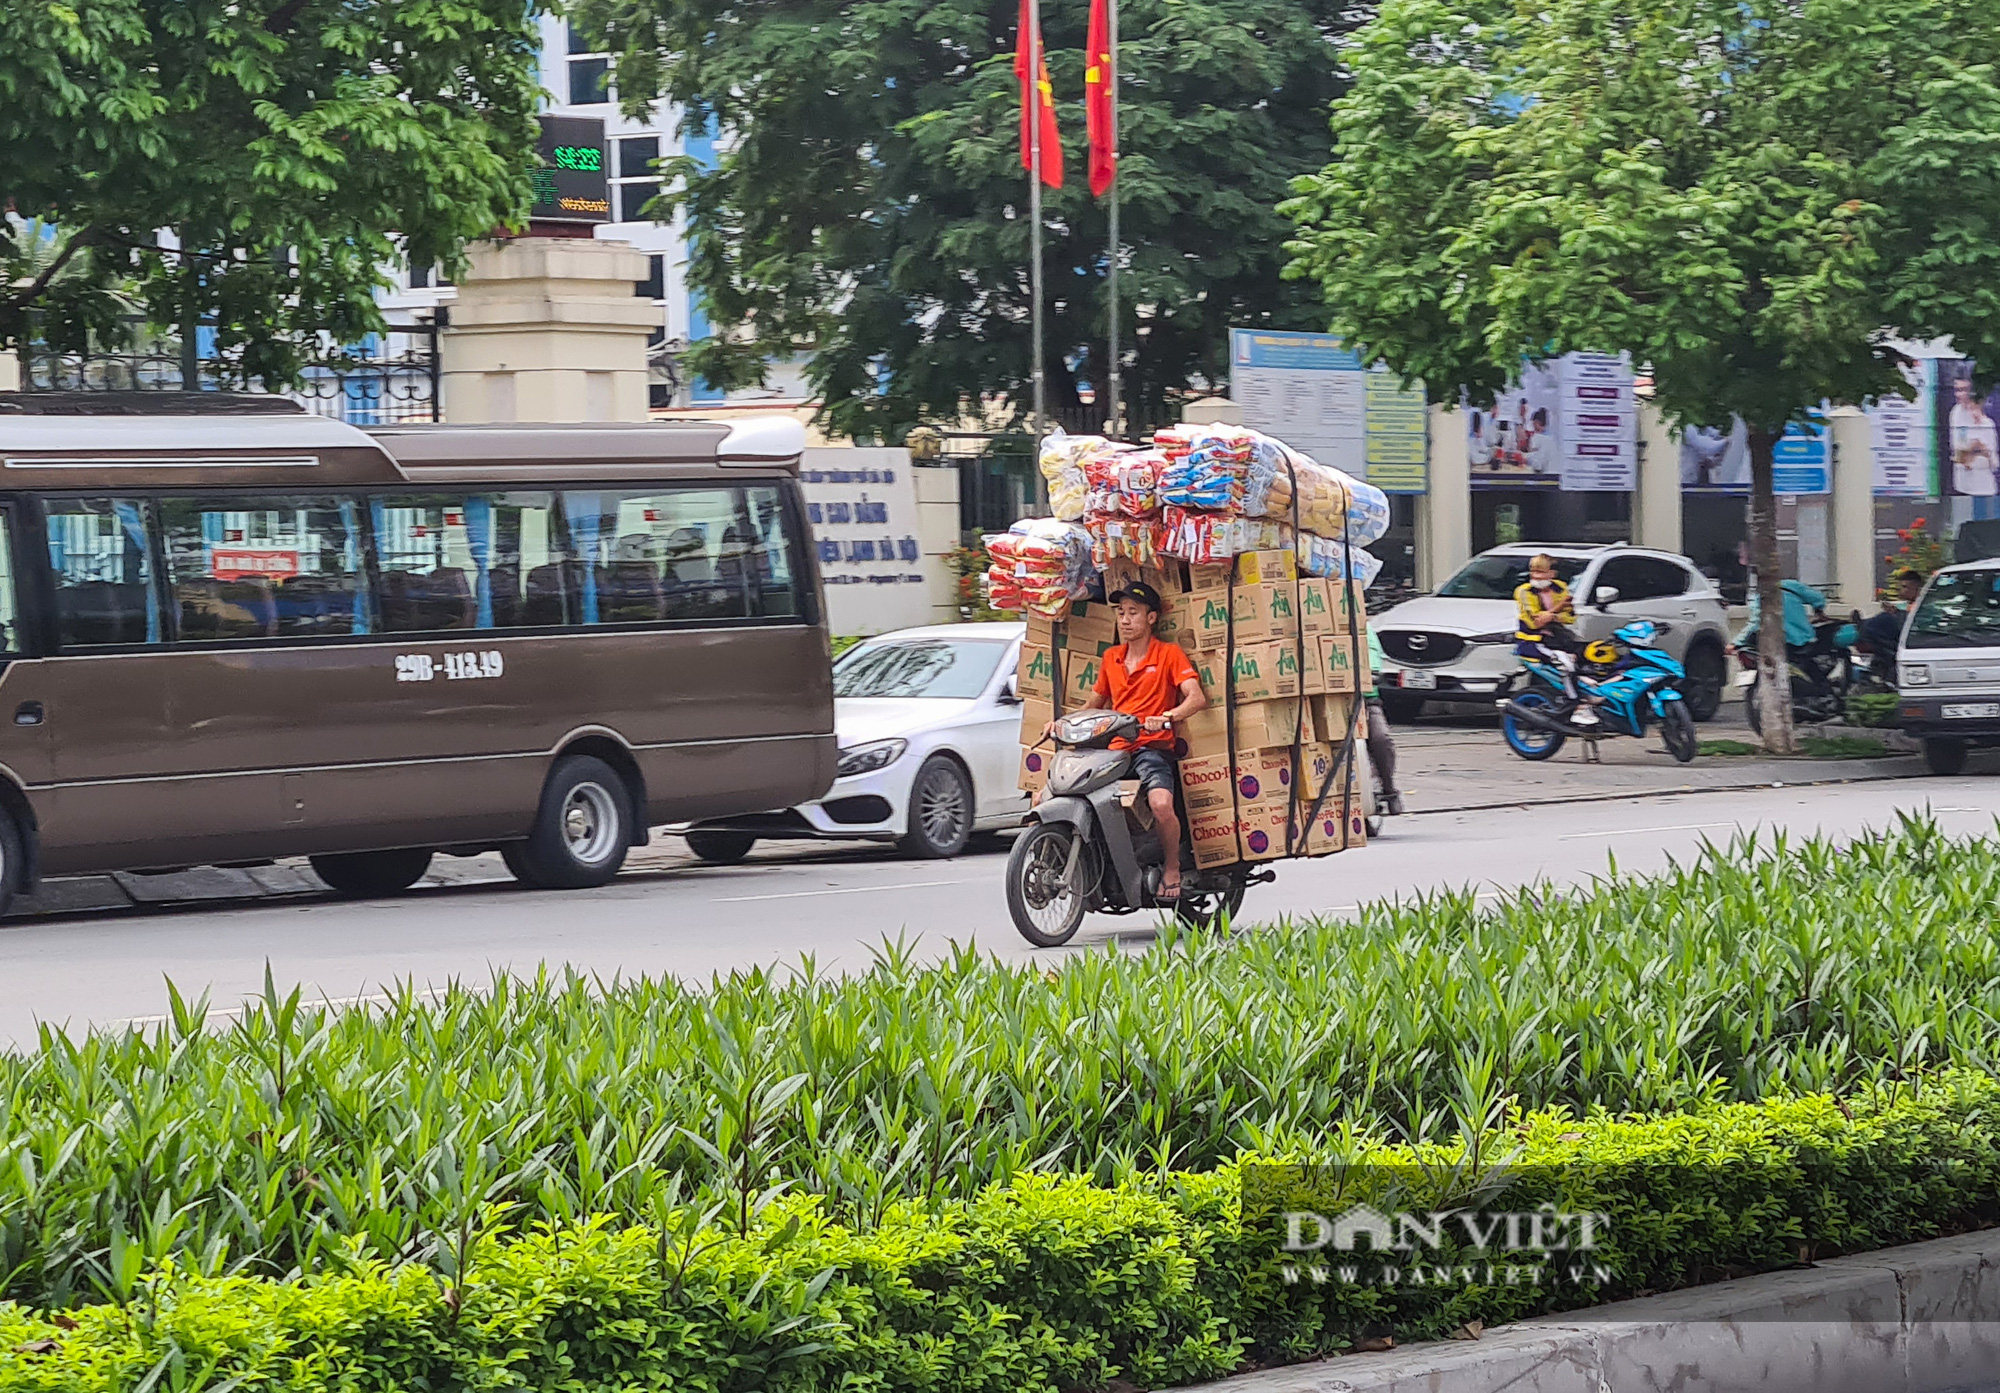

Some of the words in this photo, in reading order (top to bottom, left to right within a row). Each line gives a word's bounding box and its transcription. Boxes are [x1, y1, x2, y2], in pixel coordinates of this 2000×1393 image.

[1200, 600, 1230, 629] An
[1270, 588, 1293, 618] An
[1303, 585, 1326, 615] An
[1233, 652, 1260, 683] An
[1275, 647, 1298, 676] An
[1328, 643, 1349, 671] An
